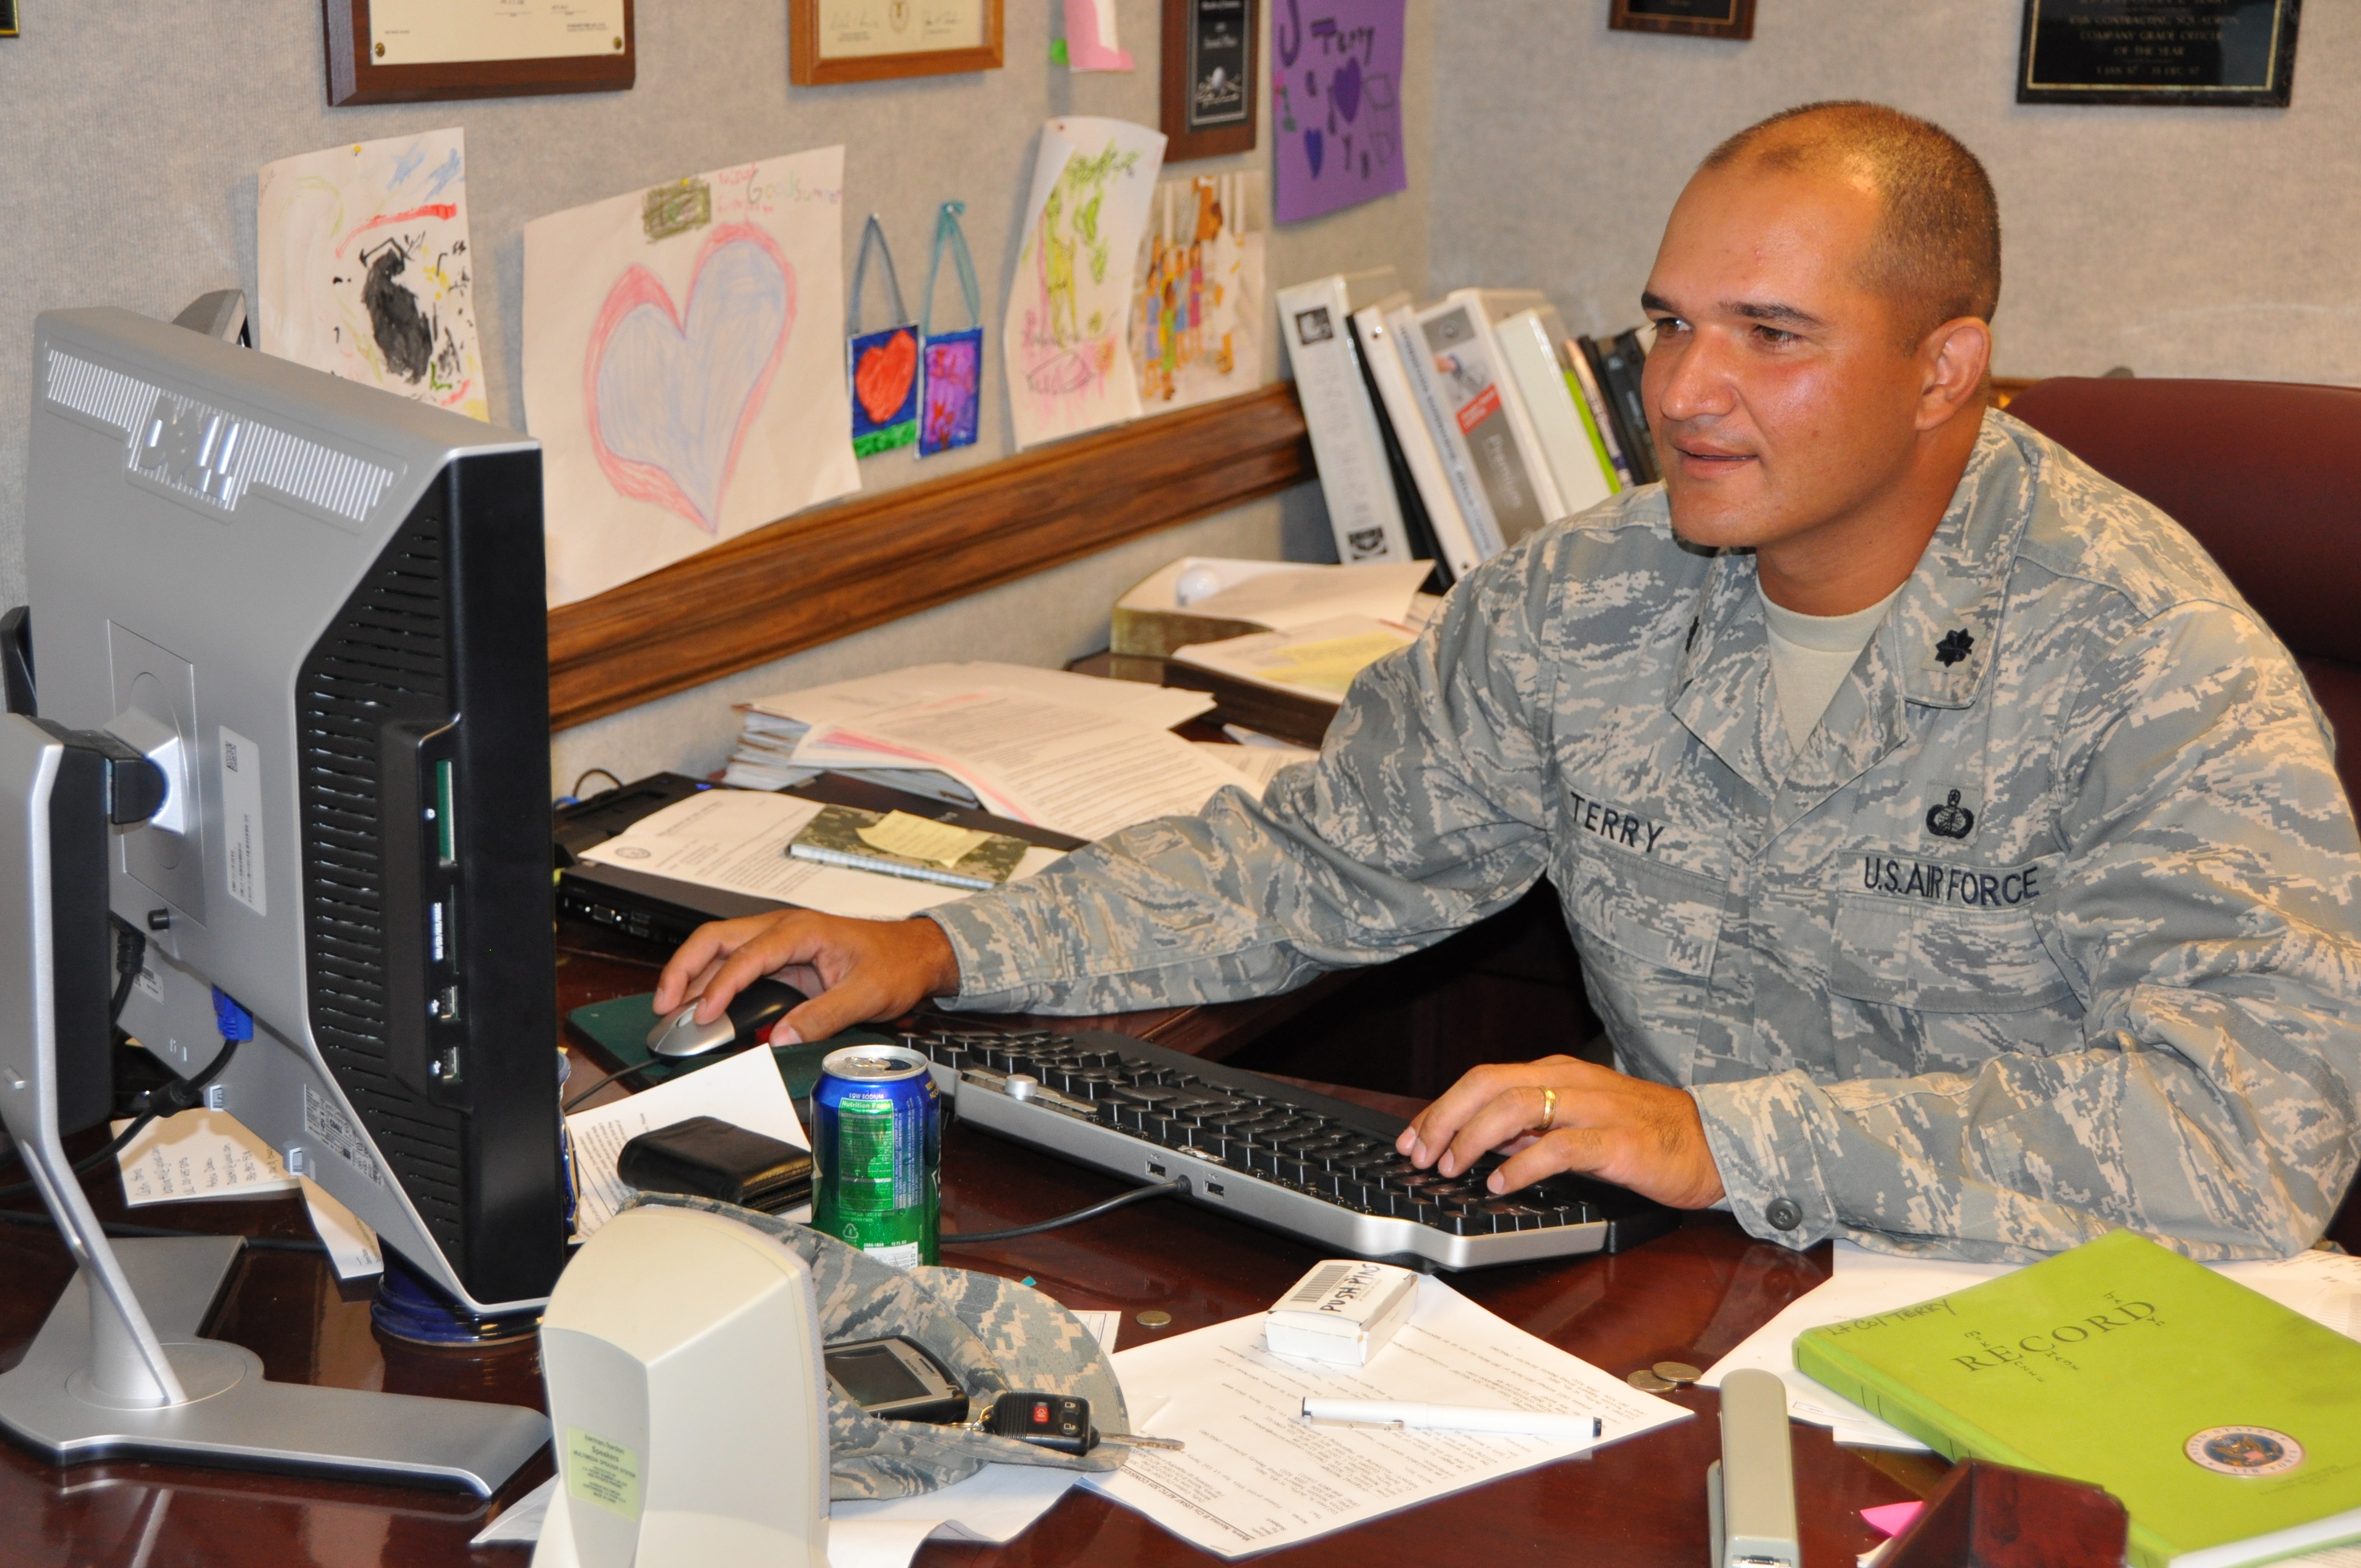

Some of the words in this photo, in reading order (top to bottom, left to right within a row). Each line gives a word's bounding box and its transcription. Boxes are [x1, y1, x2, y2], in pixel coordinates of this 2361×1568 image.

[2080, 30, 2134, 40] COMPANY
[2139, 31, 2175, 40] GRADE
[2113, 46, 2128, 55] OF
[2135, 46, 2153, 55] THE
[2158, 46, 2185, 55] YEAR
[1571, 792, 1666, 853] TERRY
[1902, 864, 1944, 900] AIR
[1948, 866, 2040, 906] FORCE
[1319, 1287, 1361, 1313] PUSH
[1343, 1264, 1381, 1284] PINS
[1826, 1323, 1851, 1336] Lt
[1854, 1315, 1885, 1331] Col
[1885, 1298, 1956, 1321] TERRY
[1950, 1301, 2156, 1371] RECORD
[585, 1434, 624, 1454] harman/kardon
[2212, 1427, 2276, 1436] STATES
[573, 1450, 599, 1462] MULTIMEDIA
[600, 1460, 619, 1470] SPEAKER
[620, 1468, 636, 1478] SYSTEM
[592, 1445, 619, 1462] Speakers
[2268, 1449, 2298, 1471] FORCE
